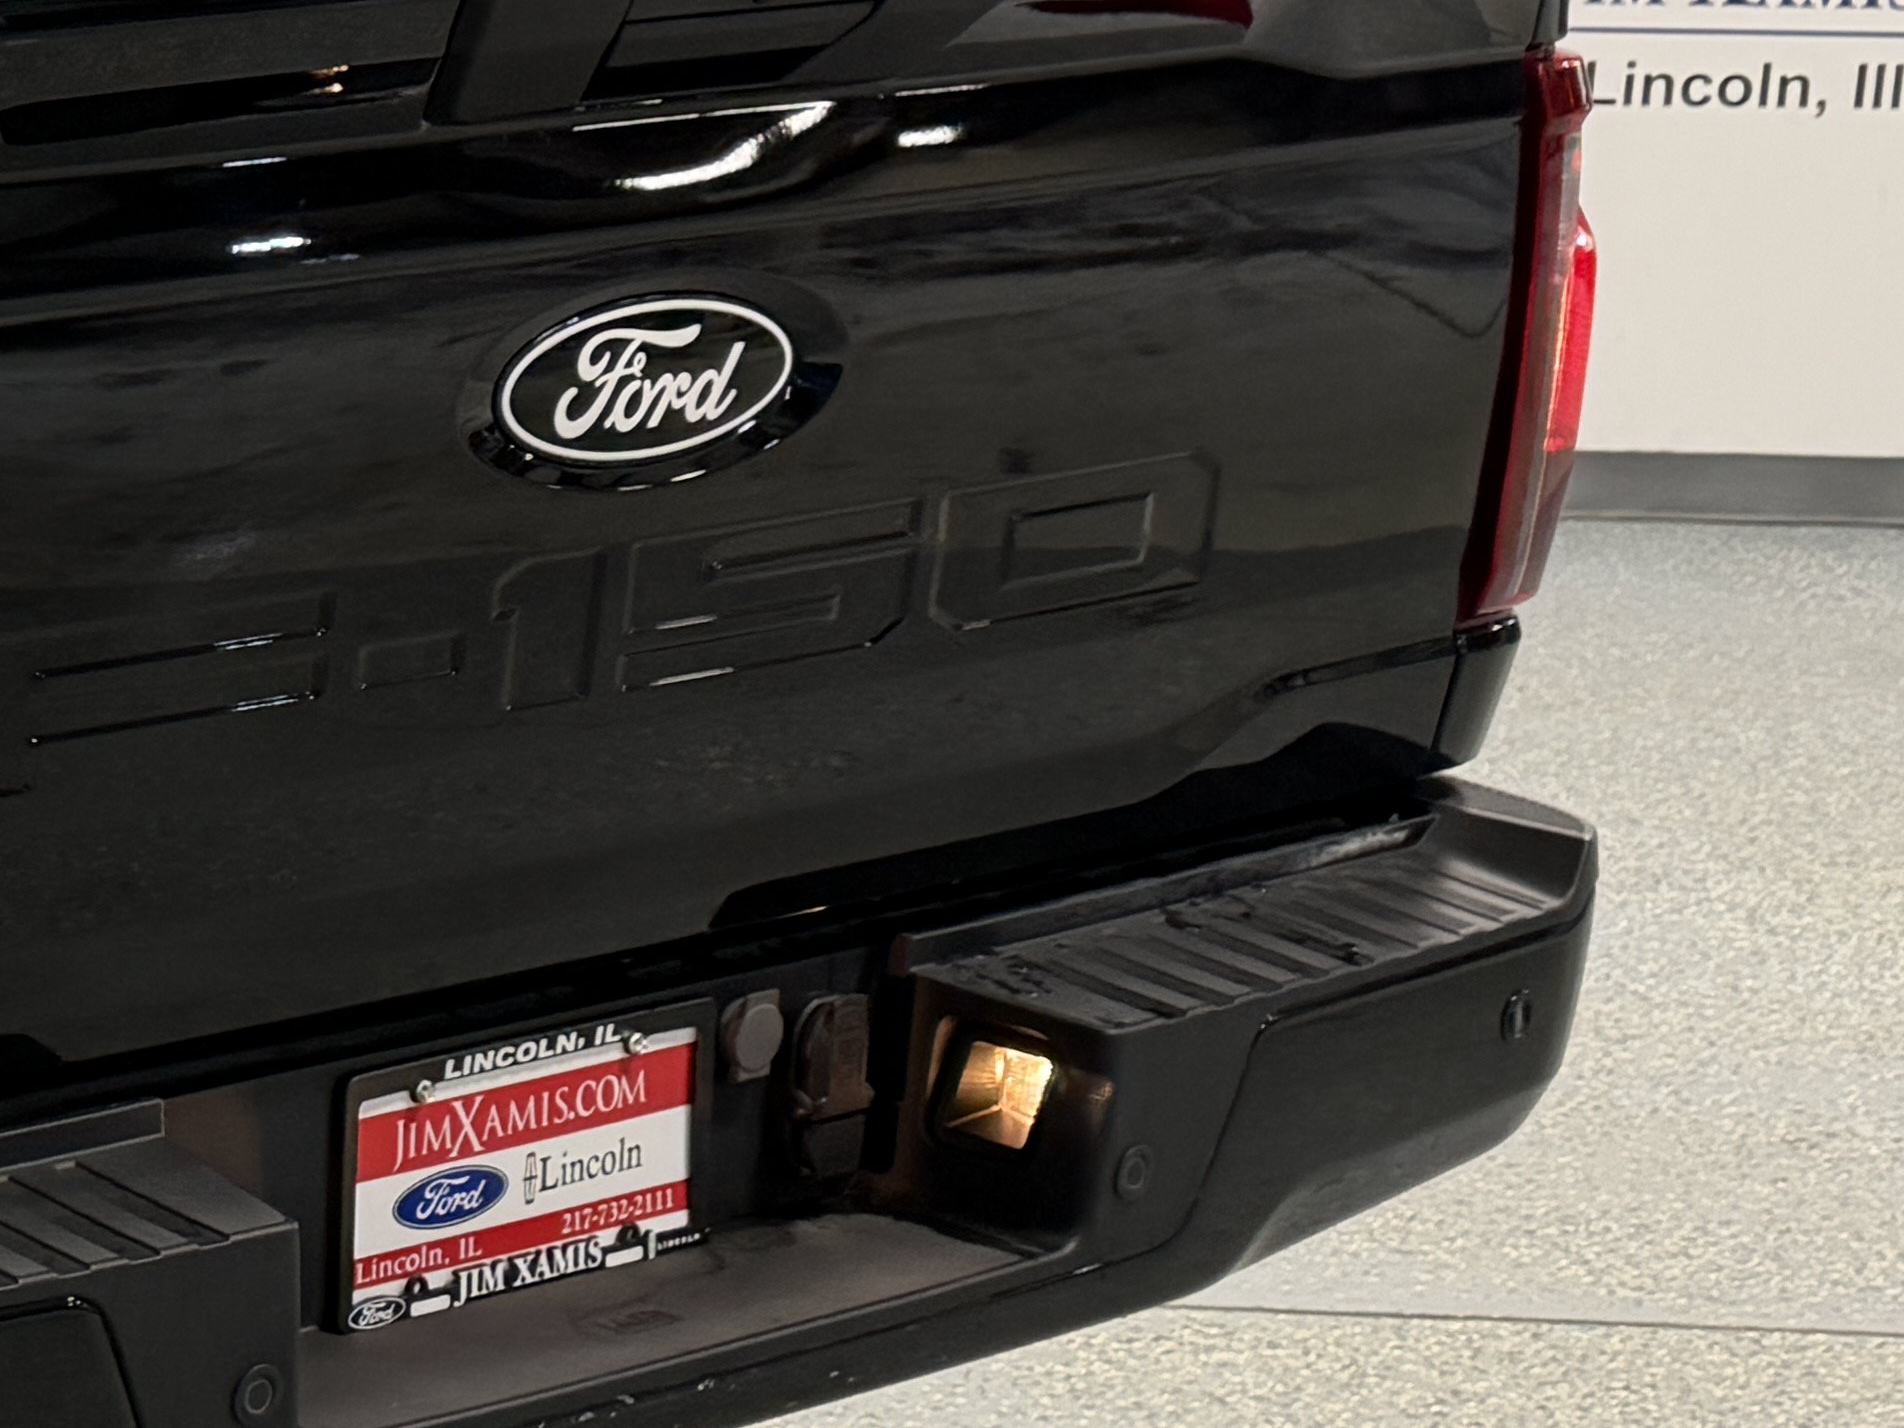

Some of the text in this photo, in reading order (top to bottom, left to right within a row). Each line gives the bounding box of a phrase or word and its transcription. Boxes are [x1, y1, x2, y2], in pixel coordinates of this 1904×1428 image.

[553, 323, 745, 442] Ford
[594, 1022, 623, 1046] IL
[539, 1137, 643, 1193] Lincoln
[416, 1174, 484, 1221] Ford
[561, 1187, 675, 1235] 217-732-2111
[459, 1235, 483, 1260] IL
[453, 1236, 605, 1308] JIM XAMIS
[359, 1302, 396, 1327] Ford
